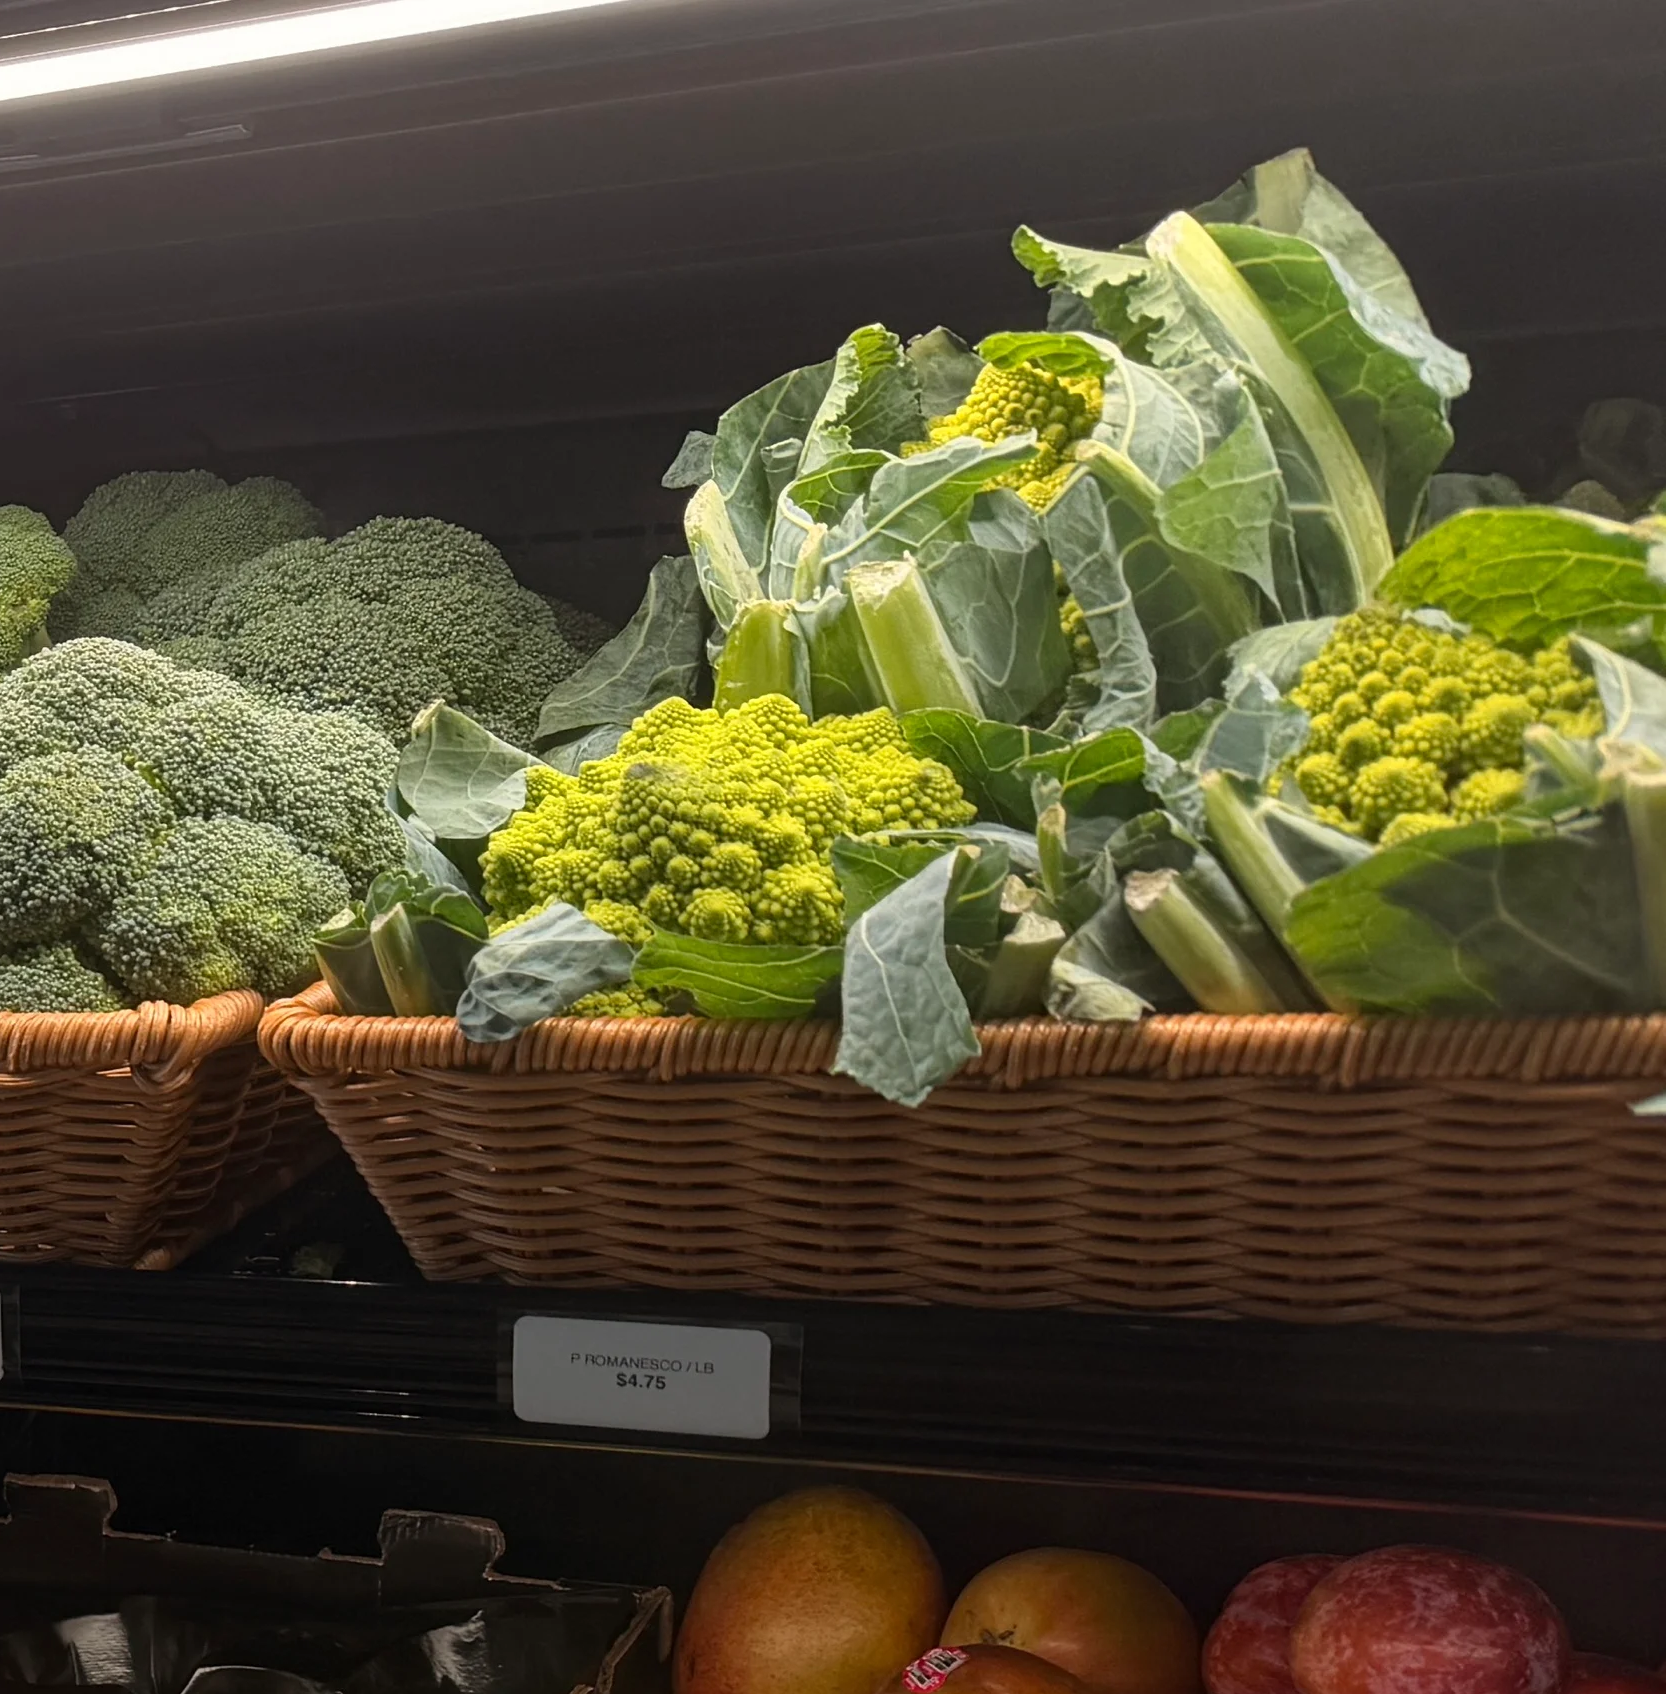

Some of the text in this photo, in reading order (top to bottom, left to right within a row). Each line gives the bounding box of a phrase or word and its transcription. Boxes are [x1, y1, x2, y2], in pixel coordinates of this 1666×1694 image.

[571, 1352, 715, 1375] P ROMANESCO LB
[616, 1371, 667, 1391] $4.75
